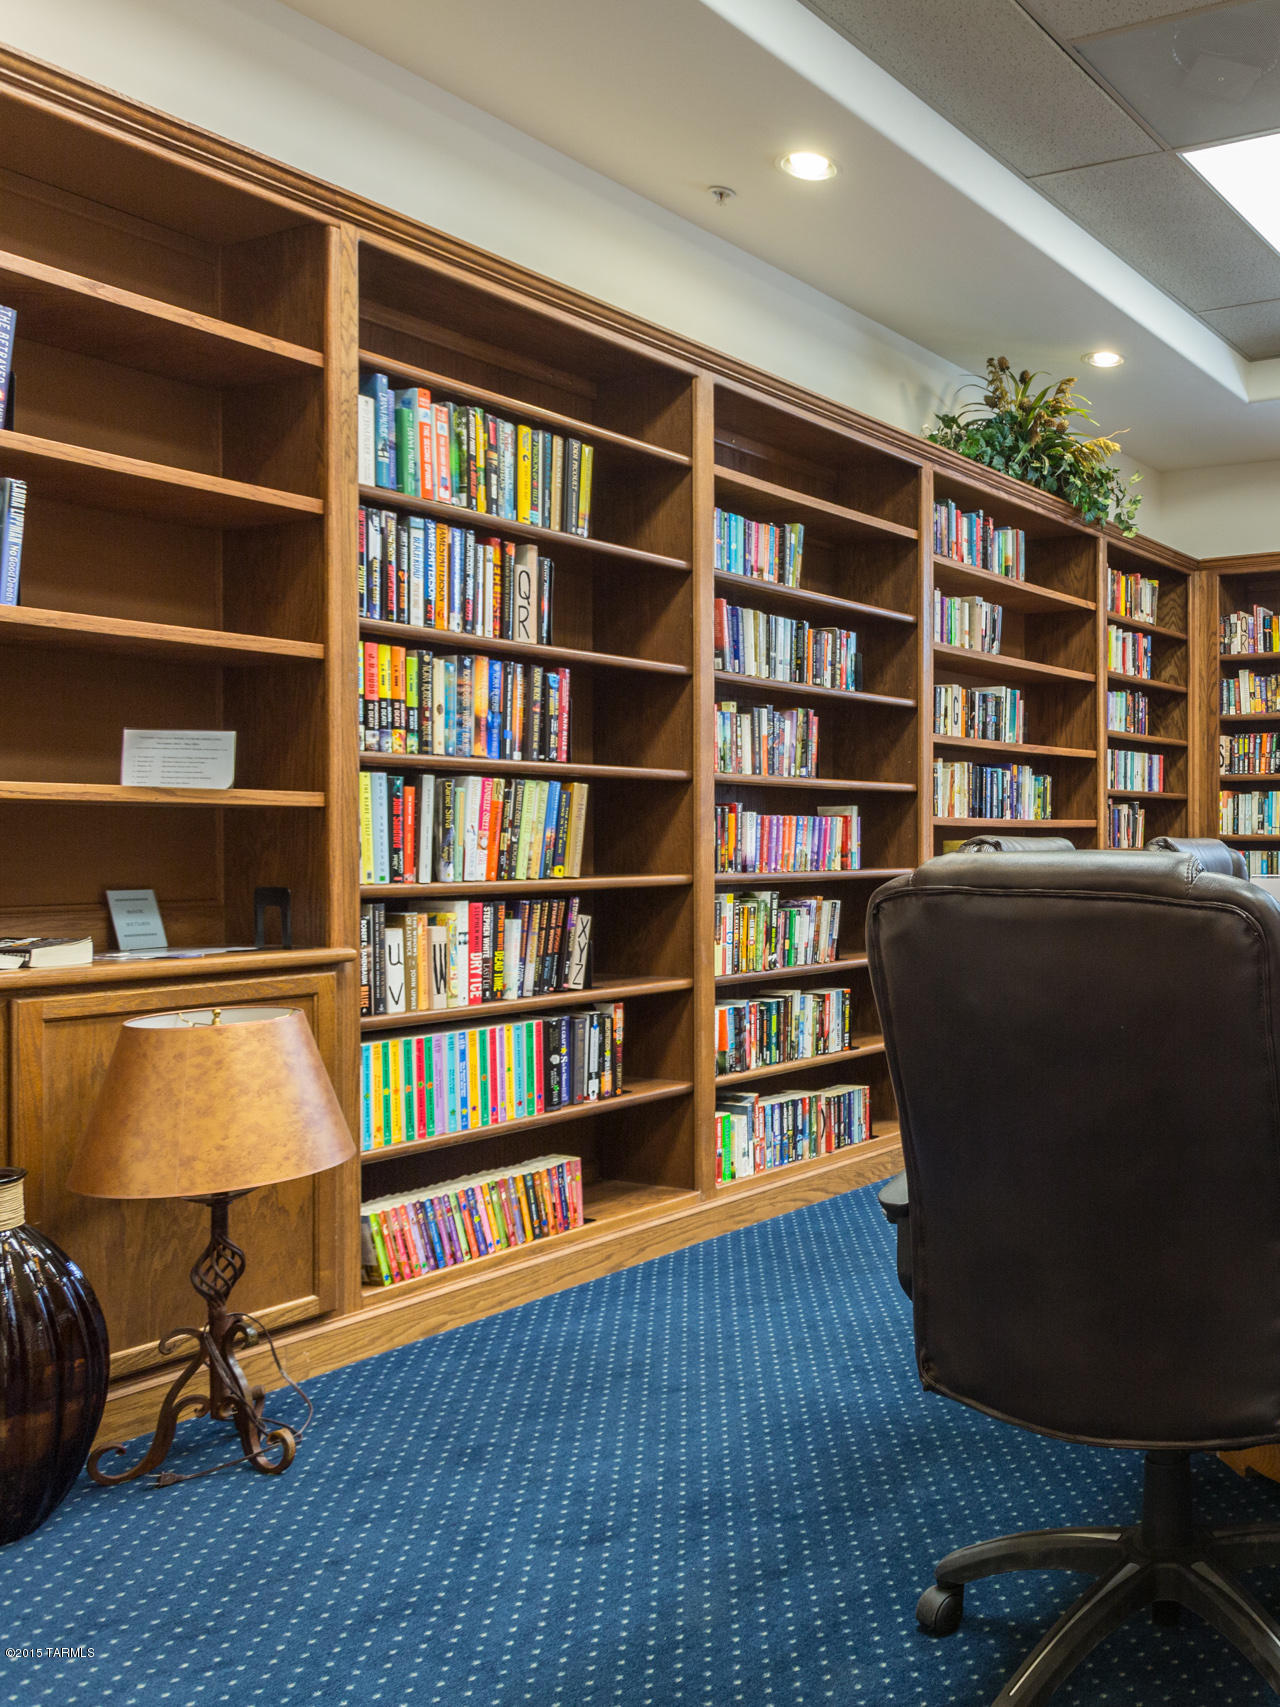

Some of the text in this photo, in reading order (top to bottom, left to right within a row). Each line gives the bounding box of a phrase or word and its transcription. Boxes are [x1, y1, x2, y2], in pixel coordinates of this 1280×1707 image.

[423, 438, 431, 462] SECOND
[424, 463, 432, 490] OPINION
[571, 460, 579, 491] PICOULT
[11, 484, 28, 509] LAURA
[427, 523, 436, 600] JAMES PATTERSON
[438, 527, 447, 602] JAMES PATTERSON
[444, 782, 454, 807] Daniel
[393, 797, 403, 848] John Sandford
[444, 809, 454, 828] Silva
[483, 906, 491, 936] STEPHEN
[550, 902, 558, 927] STUART
[571, 898, 579, 924] STUART
[483, 937, 491, 958] WHITE
[470, 952, 483, 975] DRY
[494, 950, 504, 971] DEAD
[470, 978, 483, 999] ICE
[493, 973, 504, 992] TIME
